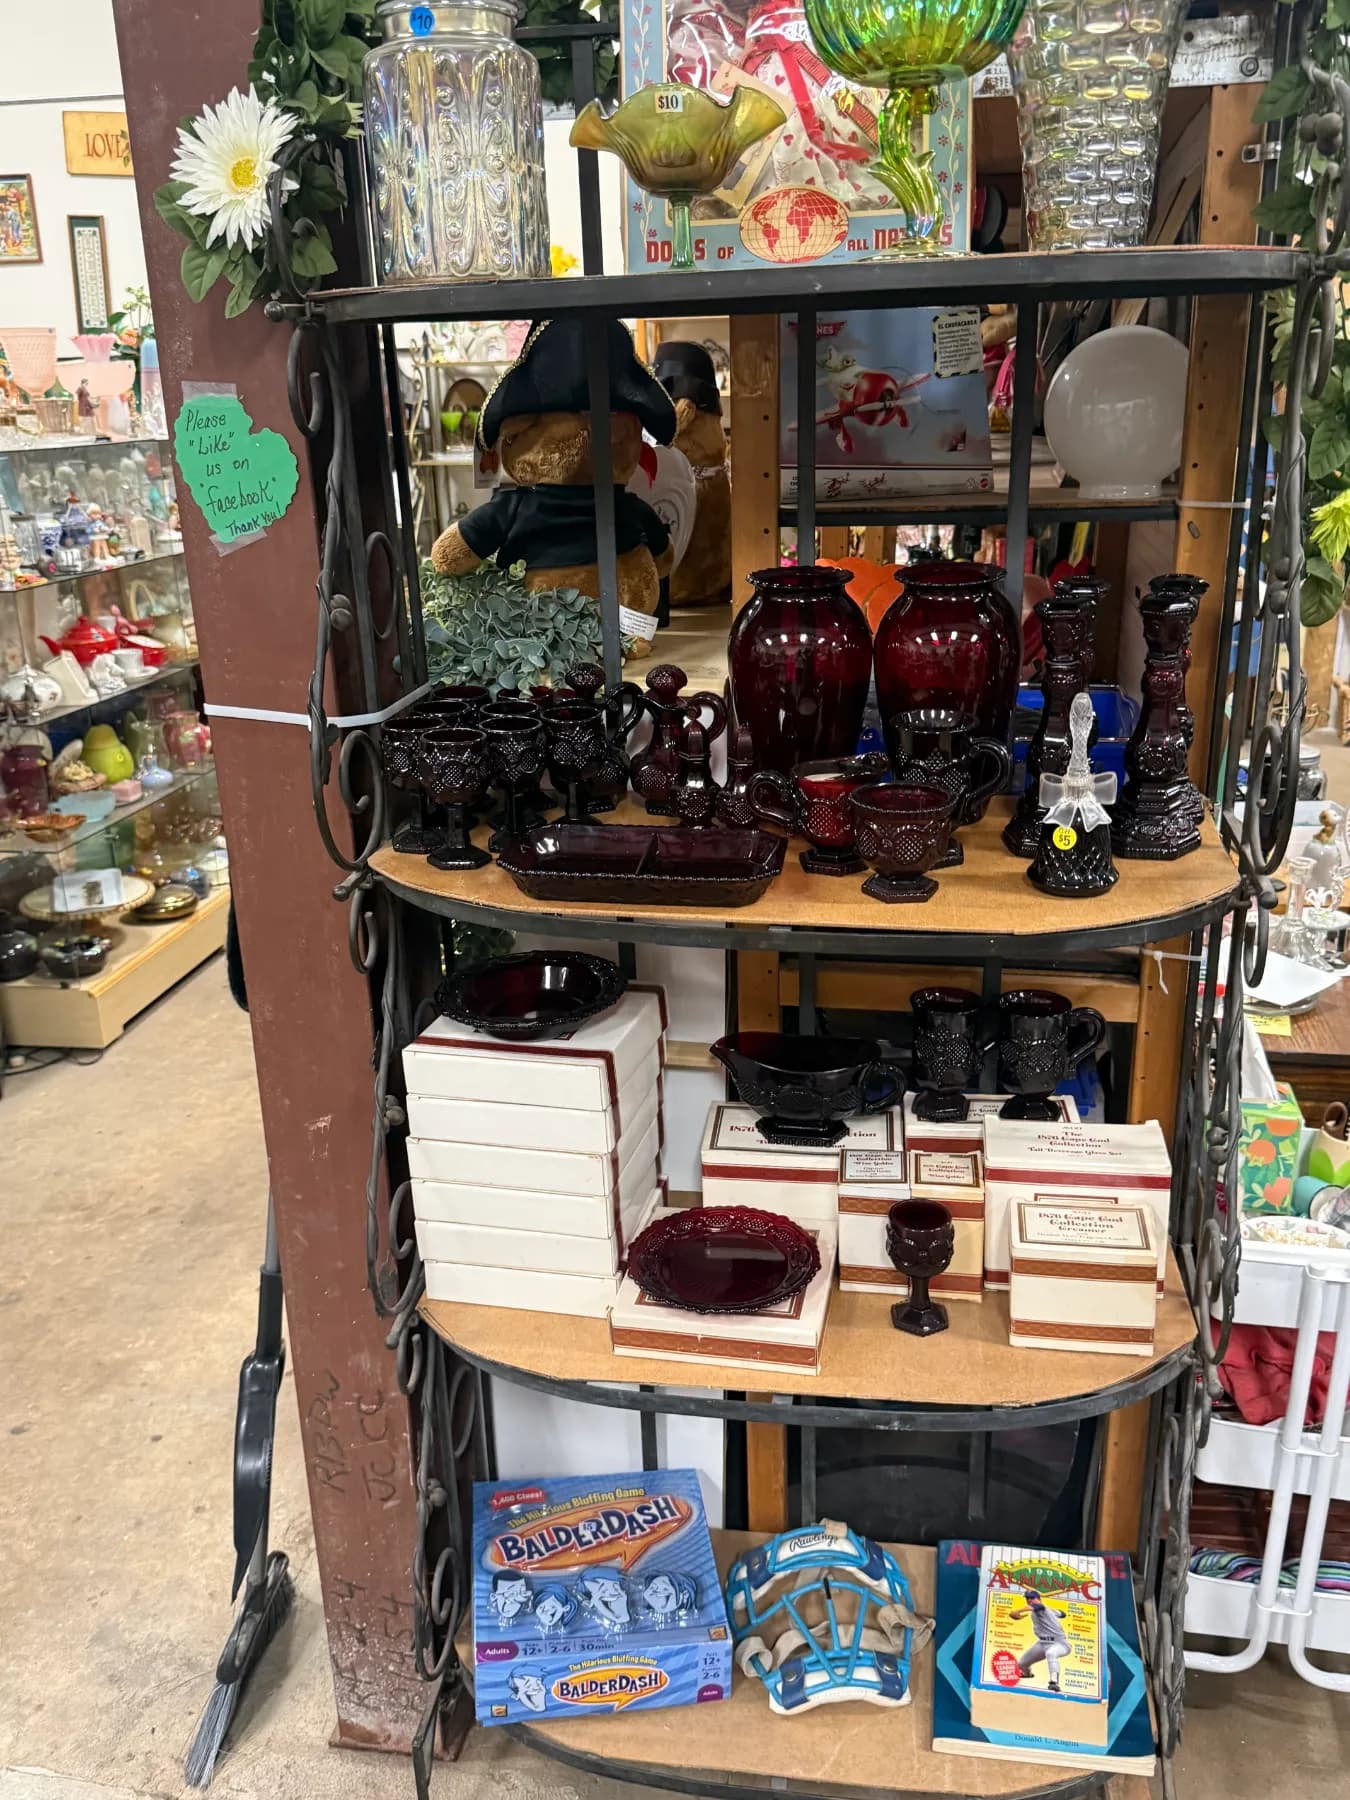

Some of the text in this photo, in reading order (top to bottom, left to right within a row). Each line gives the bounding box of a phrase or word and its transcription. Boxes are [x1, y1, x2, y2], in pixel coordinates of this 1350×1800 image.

[658, 94, 679, 110] $10
[85, 133, 123, 159] LOVE
[646, 239, 735, 263] DOS OF
[848, 239, 869, 253] ALL
[186, 408, 227, 432] Please
[206, 458, 250, 477] us on
[226, 515, 264, 537] Thank
[1058, 834, 1071, 847] $5
[507, 1518, 527, 1528] The
[571, 1491, 615, 1507] Bluffing
[615, 1487, 645, 1498] Game
[1027, 1568, 1063, 1578] 1991
[987, 1568, 1103, 1601] ALMANAC
[485, 1647, 510, 1655] Adults
[523, 1647, 543, 1656] 12+
[550, 1646, 571, 1654] 2-6
[569, 1655, 657, 1672] The Hilarious Bluffing Game
[704, 1657, 720, 1665] 12+
[703, 1672, 720, 1680] 2-6
[559, 1672, 659, 1698] BALDERDASH
